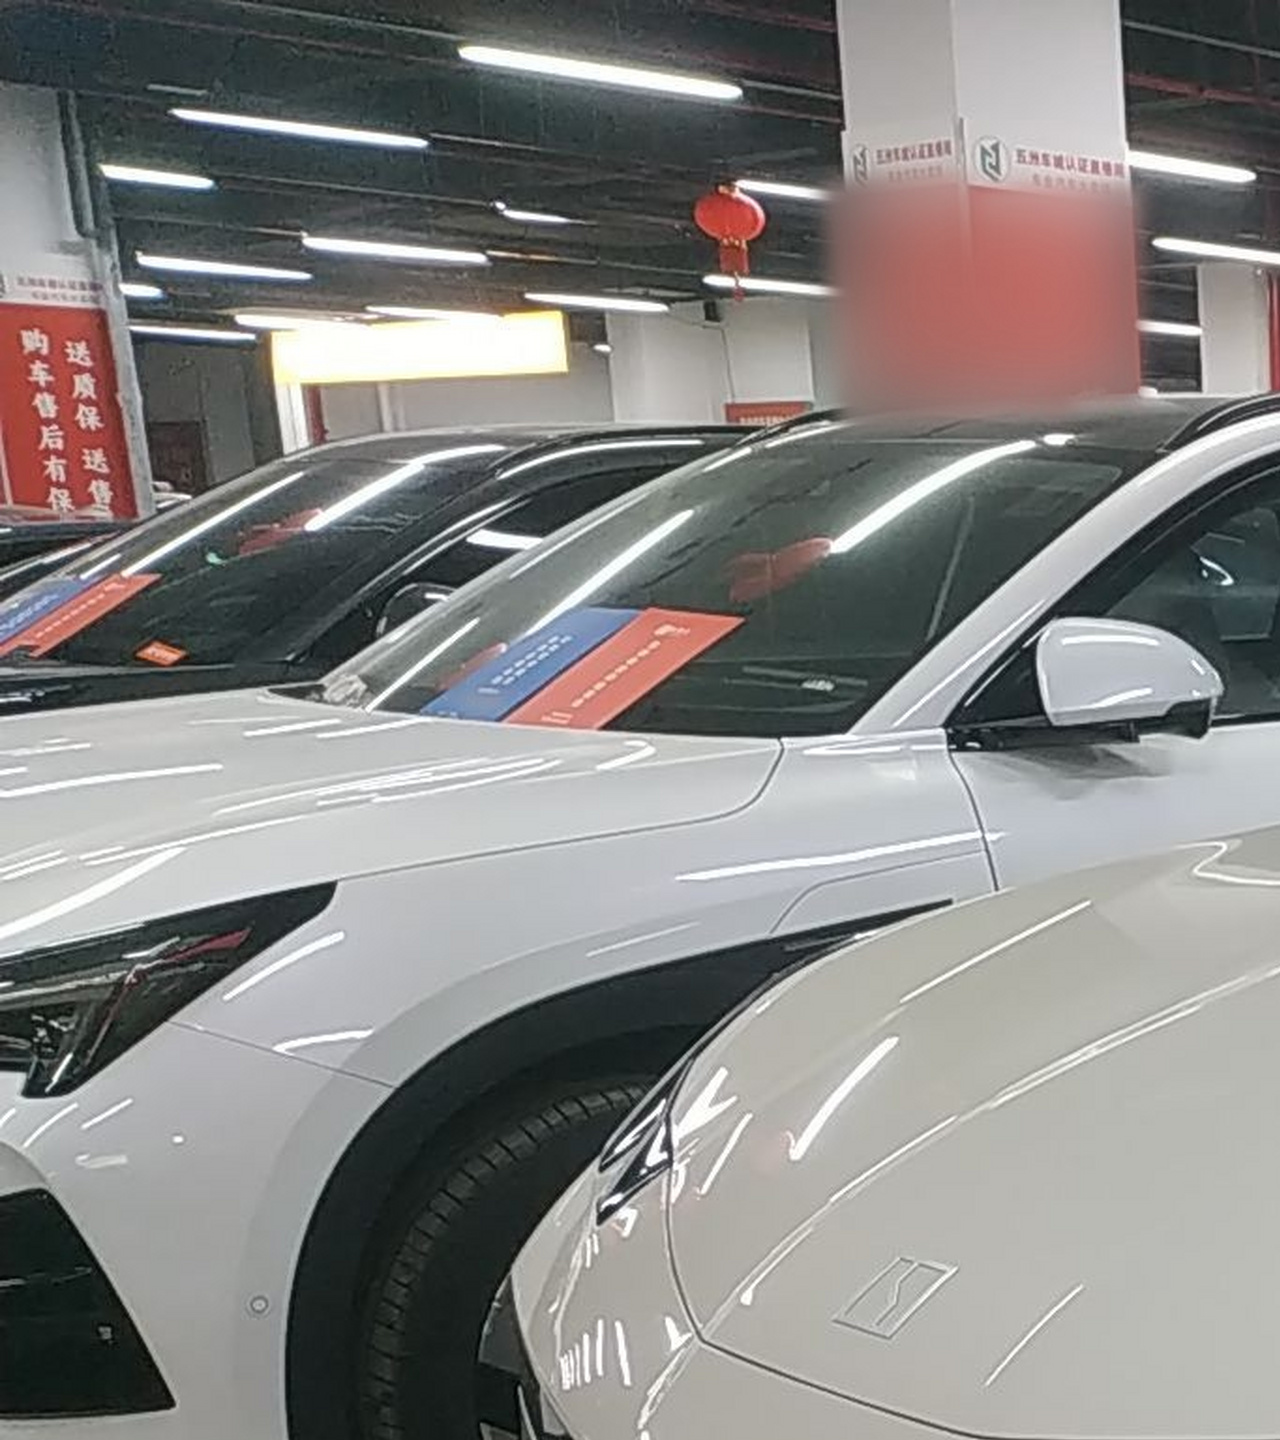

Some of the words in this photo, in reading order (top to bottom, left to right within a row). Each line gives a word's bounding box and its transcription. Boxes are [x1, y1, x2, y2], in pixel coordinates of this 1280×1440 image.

[64, 340, 105, 432] 送质保
[82, 447, 114, 513] 送售
